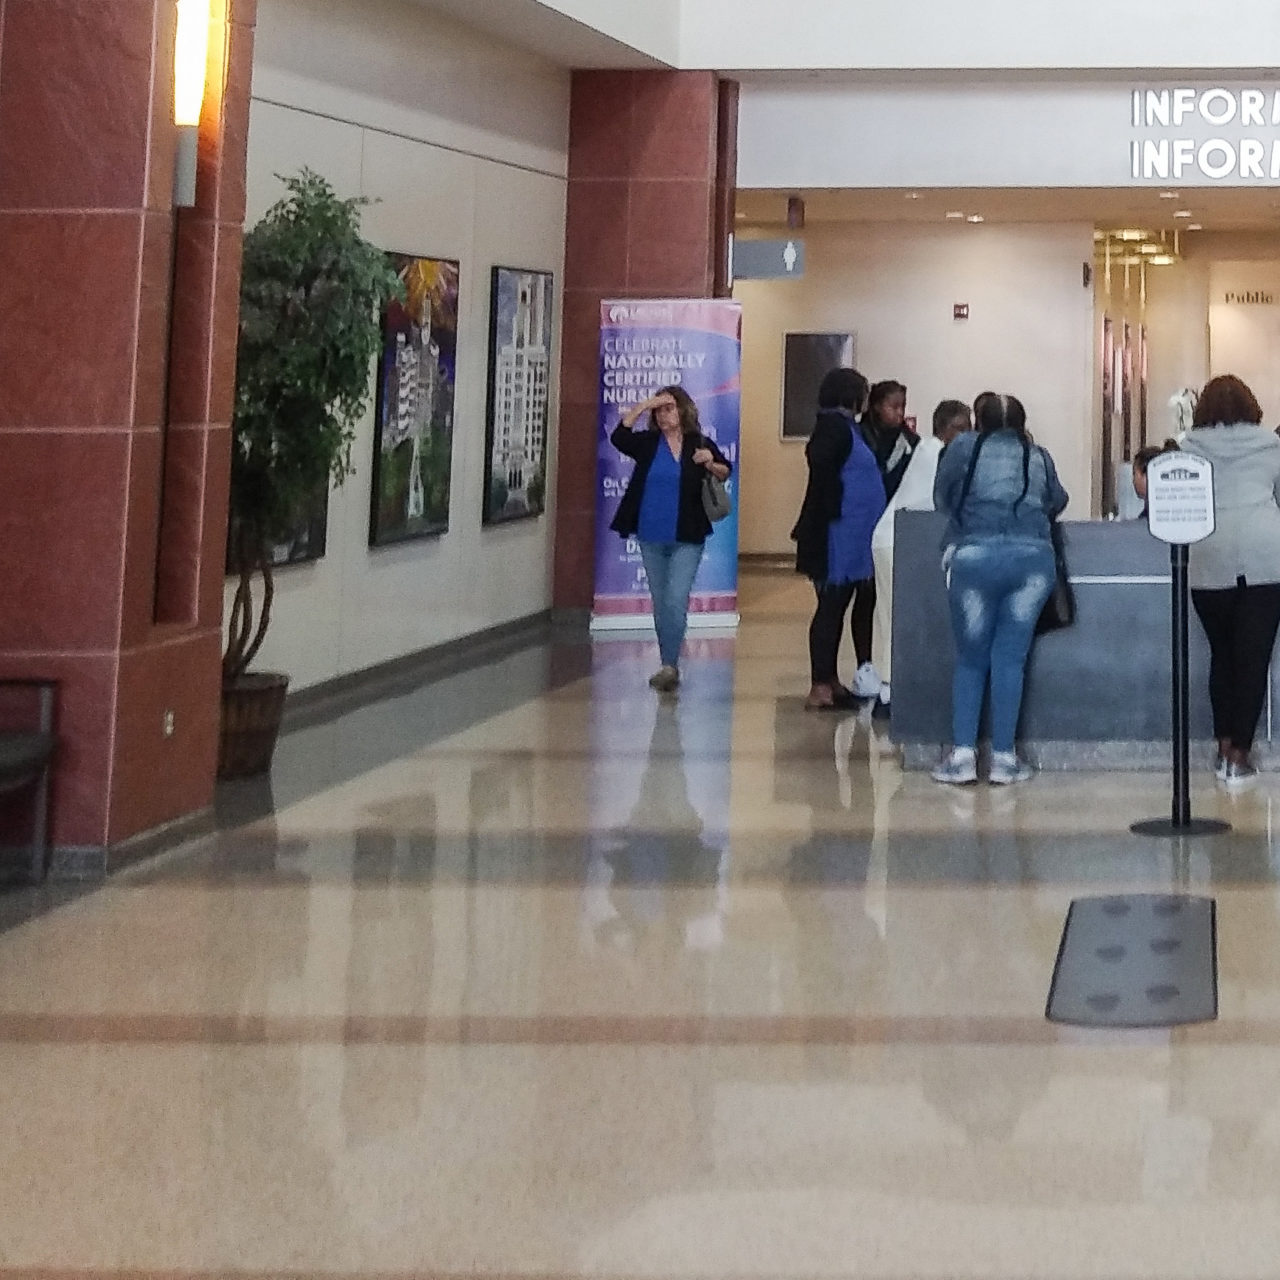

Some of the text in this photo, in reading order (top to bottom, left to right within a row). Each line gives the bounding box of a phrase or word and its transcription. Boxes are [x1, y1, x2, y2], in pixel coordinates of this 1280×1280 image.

[1224, 290, 1274, 304] Public
[604, 338, 683, 352] CELEBRATE
[604, 353, 706, 369] NATIONALLY
[603, 370, 683, 386] CERTIFIED
[603, 387, 656, 404] NURSE
